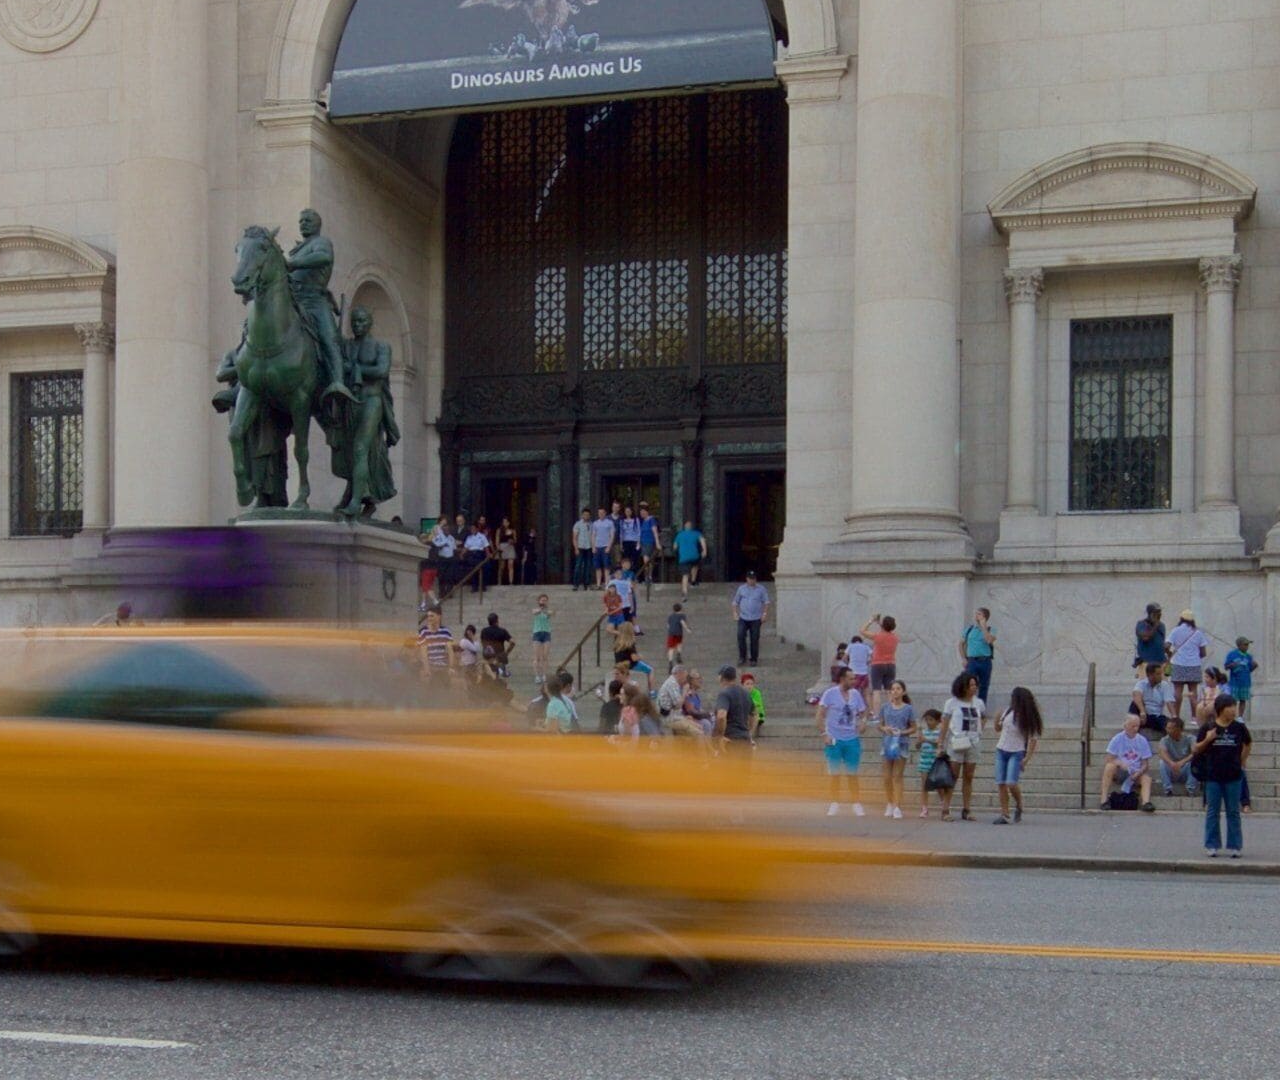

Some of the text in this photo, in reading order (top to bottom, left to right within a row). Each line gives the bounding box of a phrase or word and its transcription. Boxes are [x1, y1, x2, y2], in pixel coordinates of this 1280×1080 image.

[451, 56, 642, 89] DINOSAURS AMONG US
